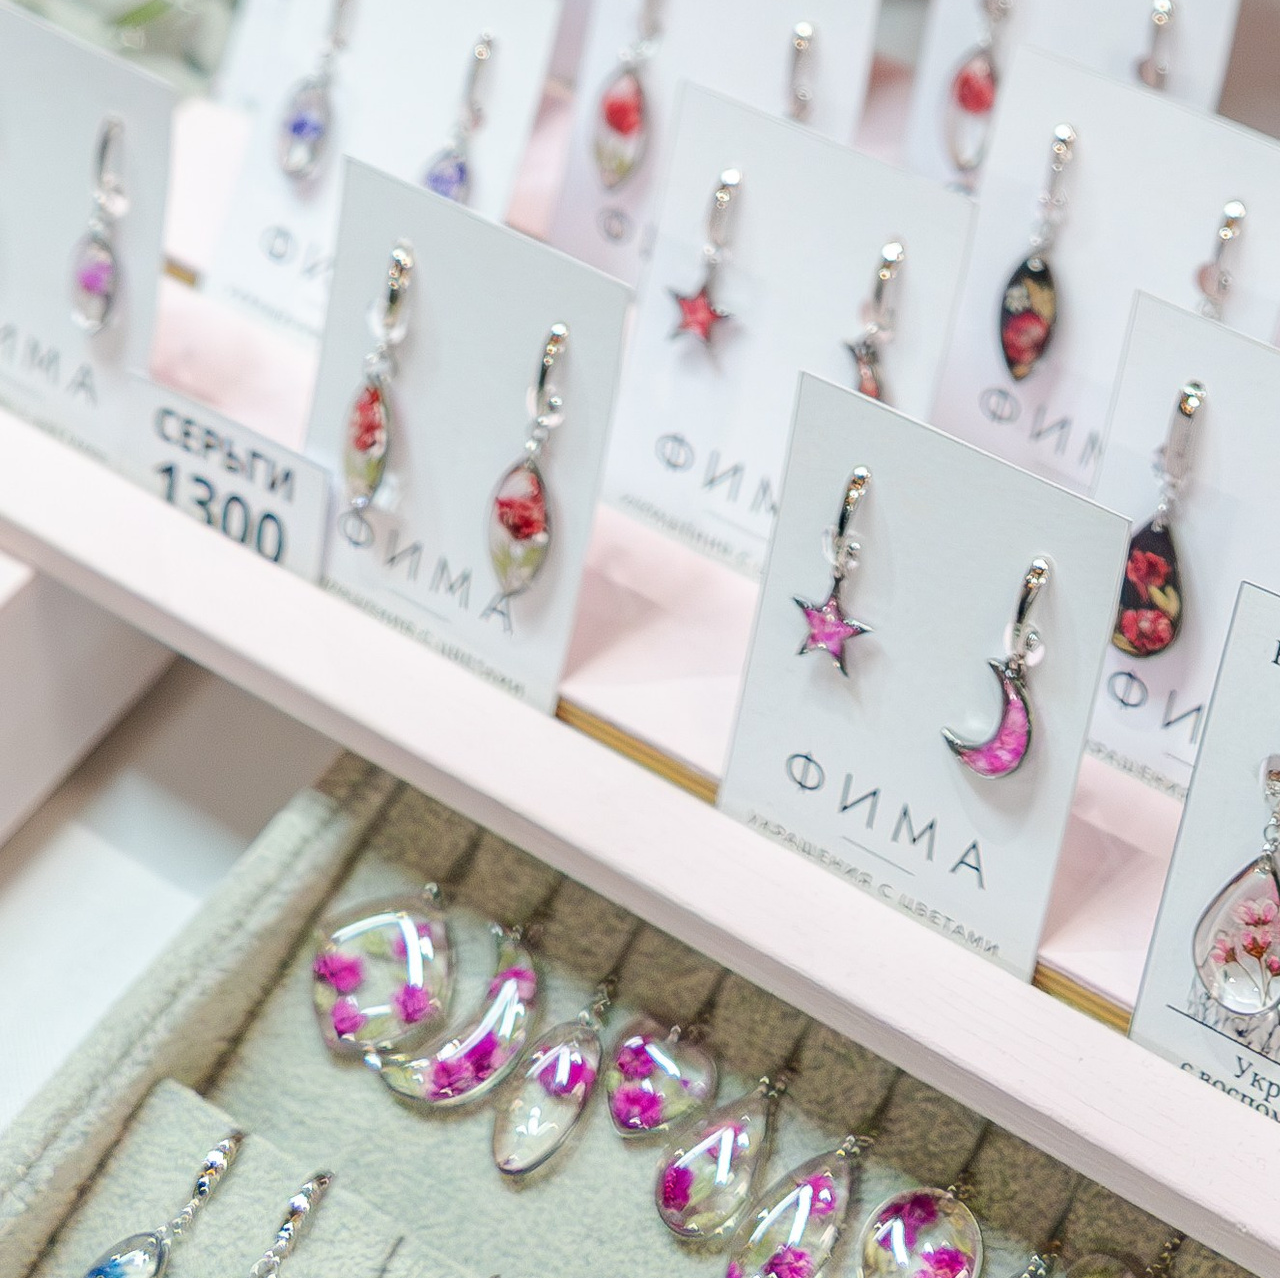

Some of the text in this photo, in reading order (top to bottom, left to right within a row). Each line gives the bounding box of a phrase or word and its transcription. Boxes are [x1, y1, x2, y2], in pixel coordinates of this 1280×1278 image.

[154, 405, 296, 502] СЕРЬГИ
[156, 463, 285, 563] 1300
[786, 750, 986, 891] ФИМА
